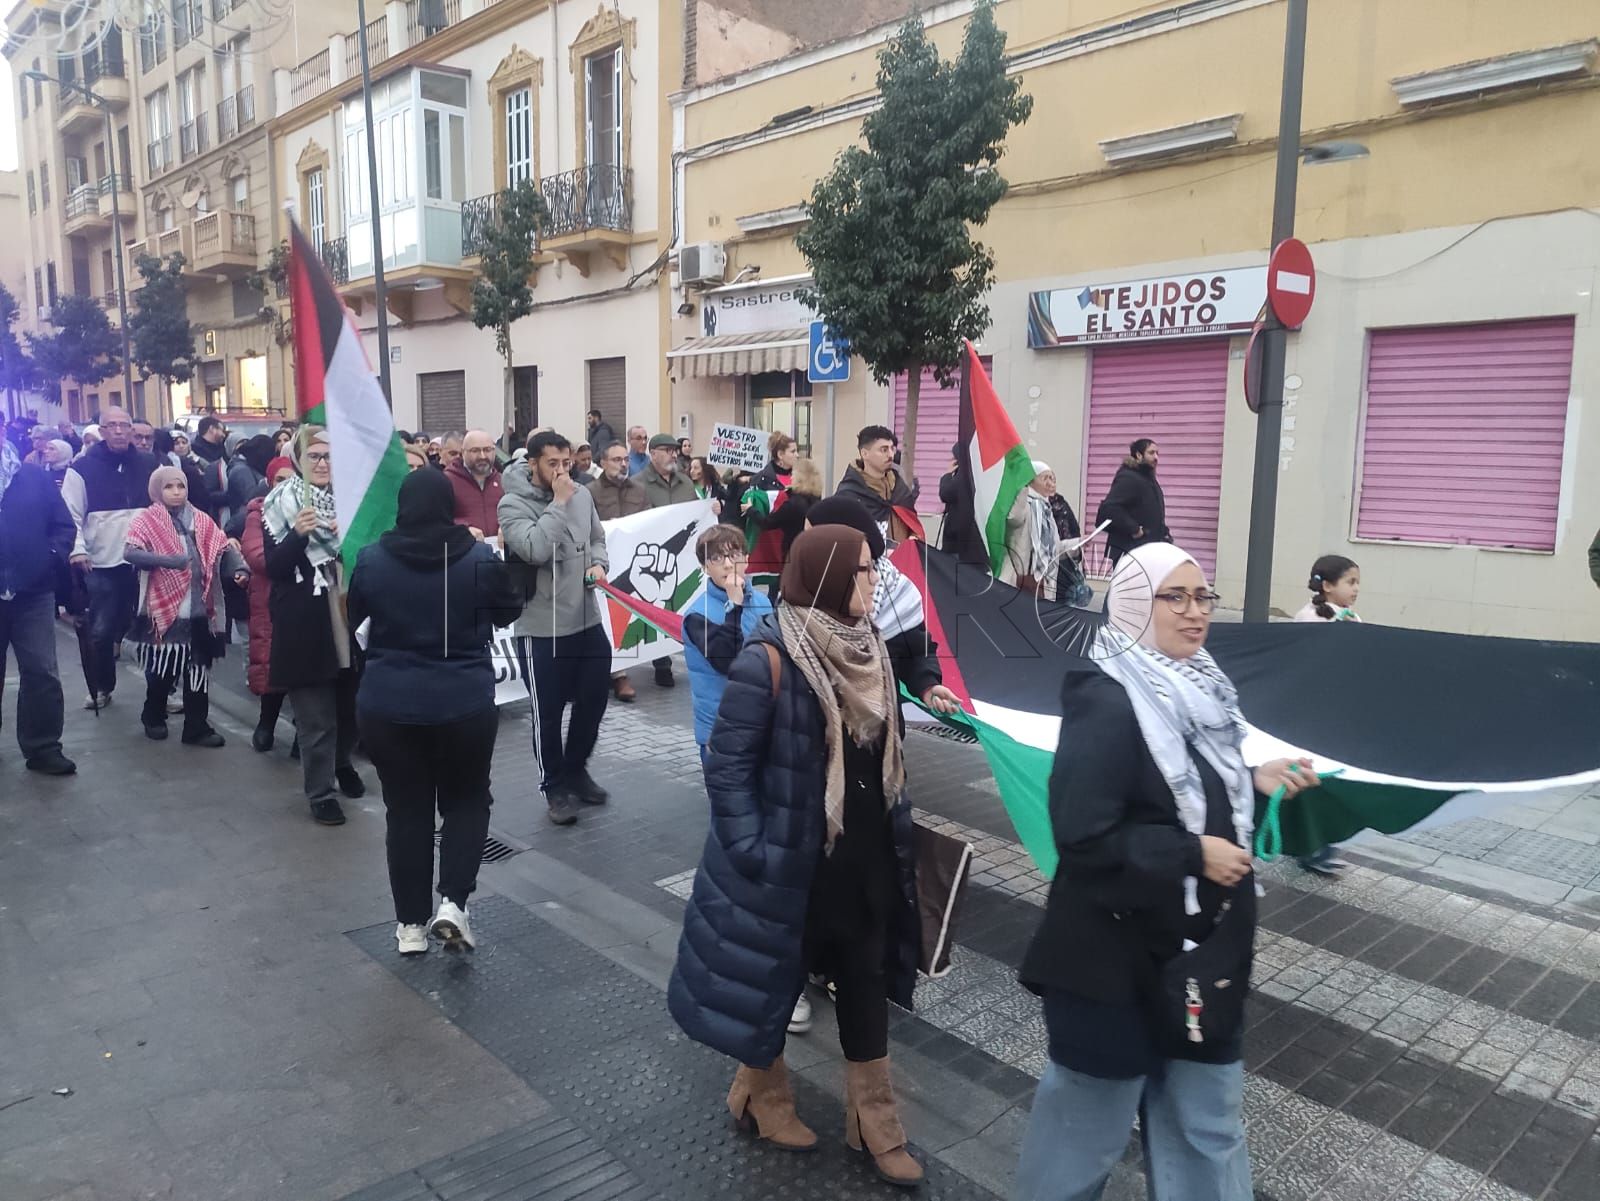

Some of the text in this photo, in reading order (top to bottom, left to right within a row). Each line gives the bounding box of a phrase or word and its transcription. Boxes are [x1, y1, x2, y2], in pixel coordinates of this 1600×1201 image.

[1101, 276, 1227, 311] TEJIDOS
[1086, 313, 1113, 333] EL
[1123, 303, 1218, 331] SANTO
[717, 427, 757, 443] VUESTRO
[710, 452, 742, 466] VUESTROS
